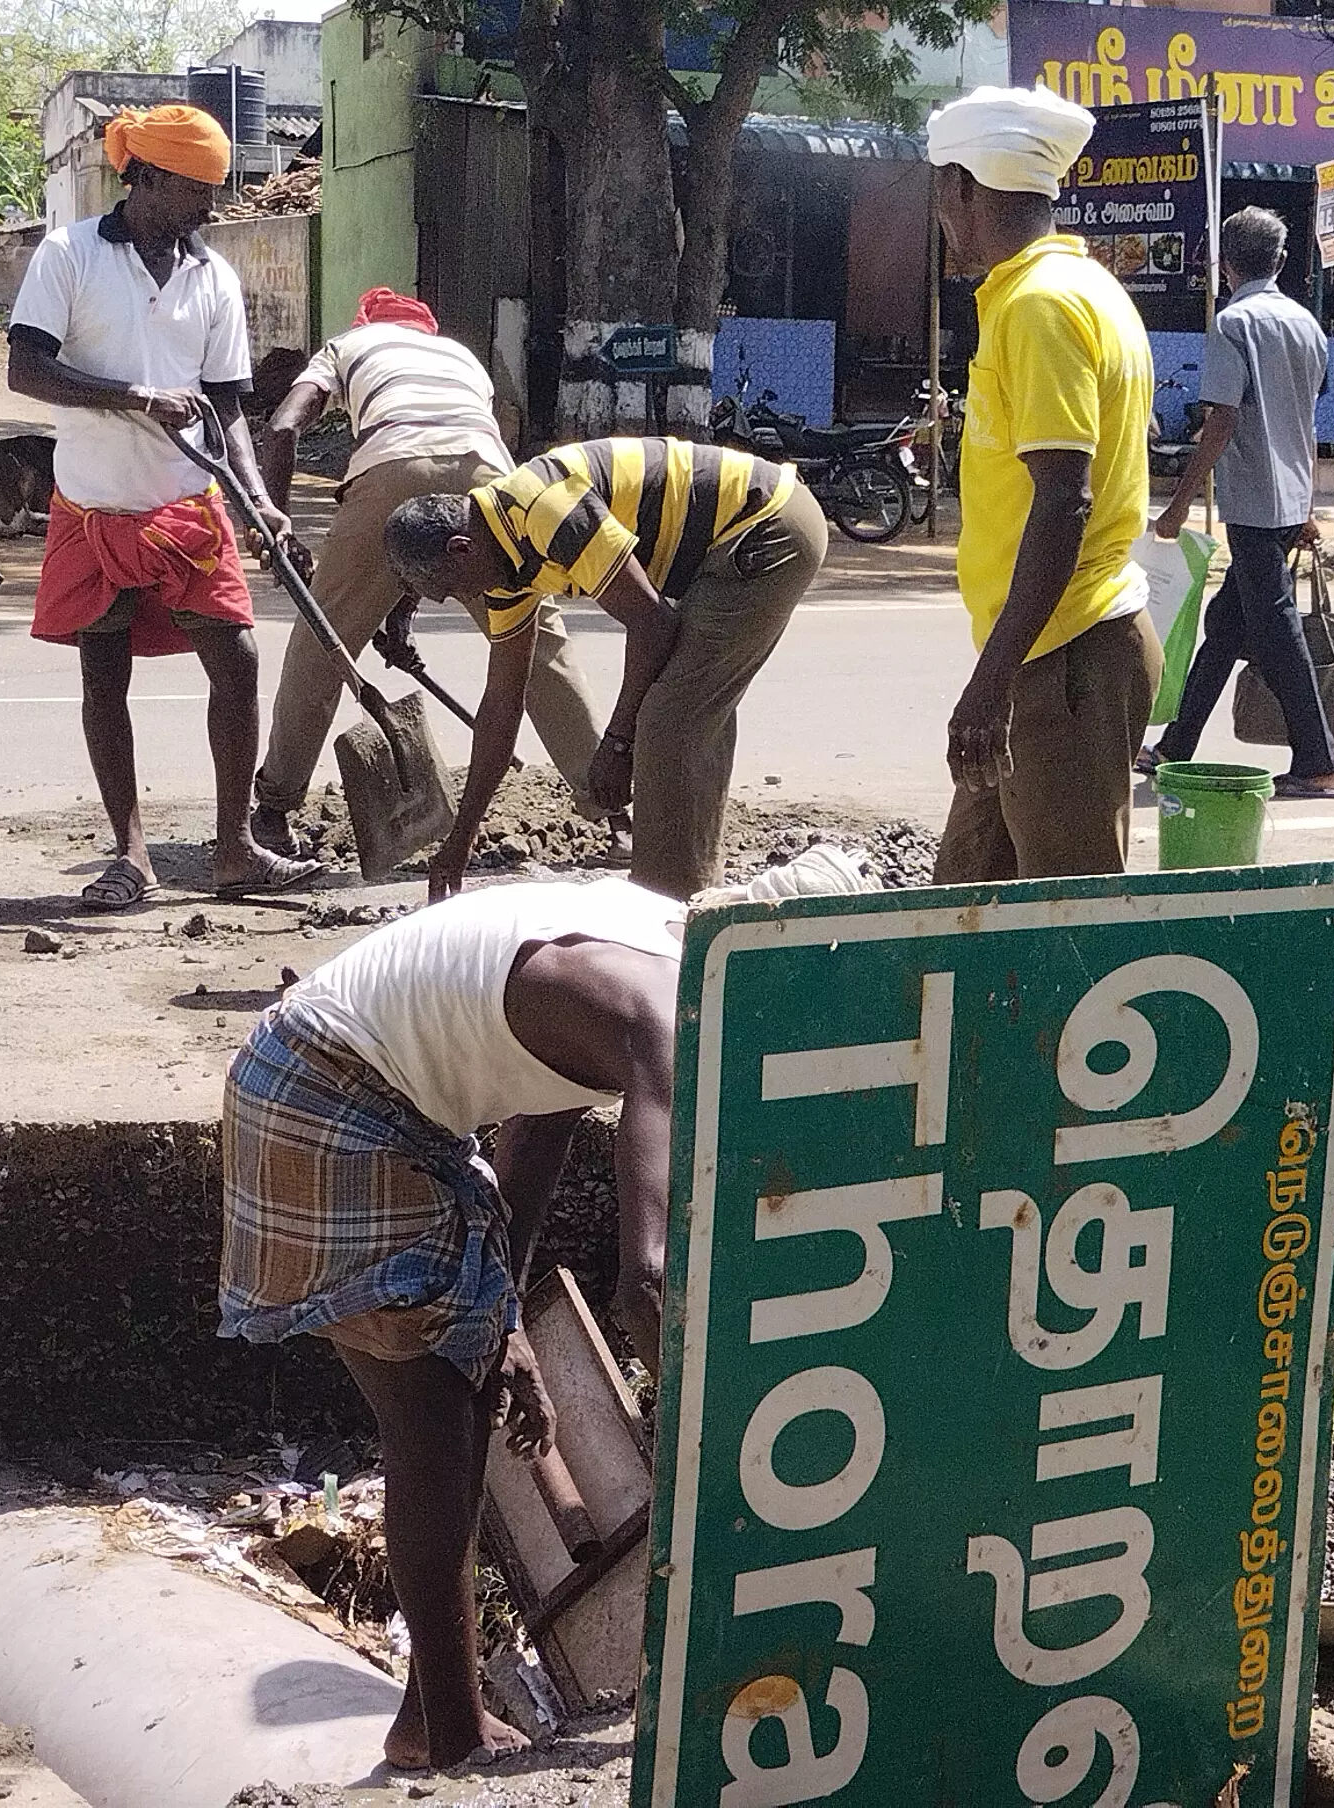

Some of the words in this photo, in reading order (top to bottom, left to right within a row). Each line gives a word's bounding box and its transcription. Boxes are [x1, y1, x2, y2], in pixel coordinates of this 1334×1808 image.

[1146, 33, 1303, 128] மீனா
[1077, 136, 1200, 187] உணவகம்
[1084, 202, 1097, 225] &
[1101, 188, 1175, 225] அசைவம்
[720, 971, 955, 1808] Thora
[1228, 1114, 1317, 1741] நெடுஞ்சாலைத்துறை
